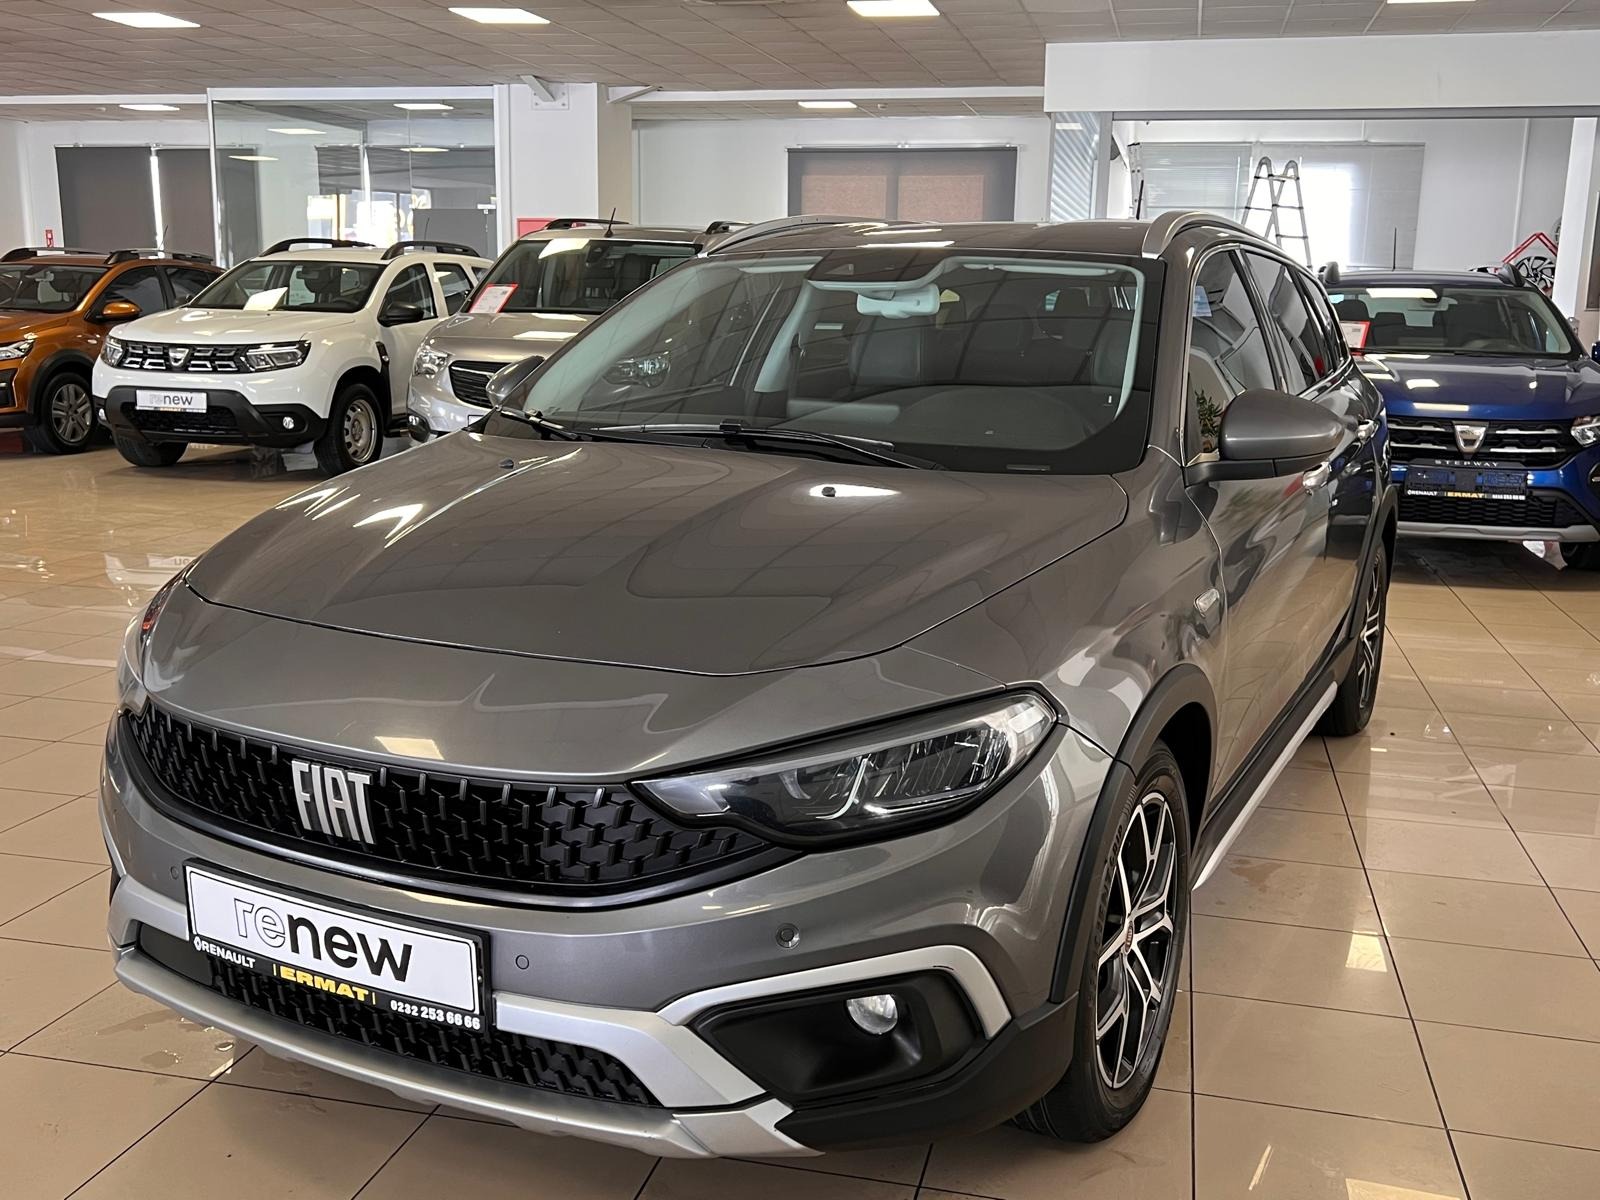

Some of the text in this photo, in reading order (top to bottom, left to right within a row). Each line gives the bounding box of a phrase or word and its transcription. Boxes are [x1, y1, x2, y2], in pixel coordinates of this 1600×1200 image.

[1434, 459, 1499, 467] STEPWAY
[1447, 491, 1485, 499] ERMAT
[291, 760, 375, 845] FIAT
[201, 939, 257, 969] RENAULT
[233, 897, 412, 982] renew
[279, 966, 370, 1002] ERMAT
[390, 999, 481, 1031] 0232 253 66 66
